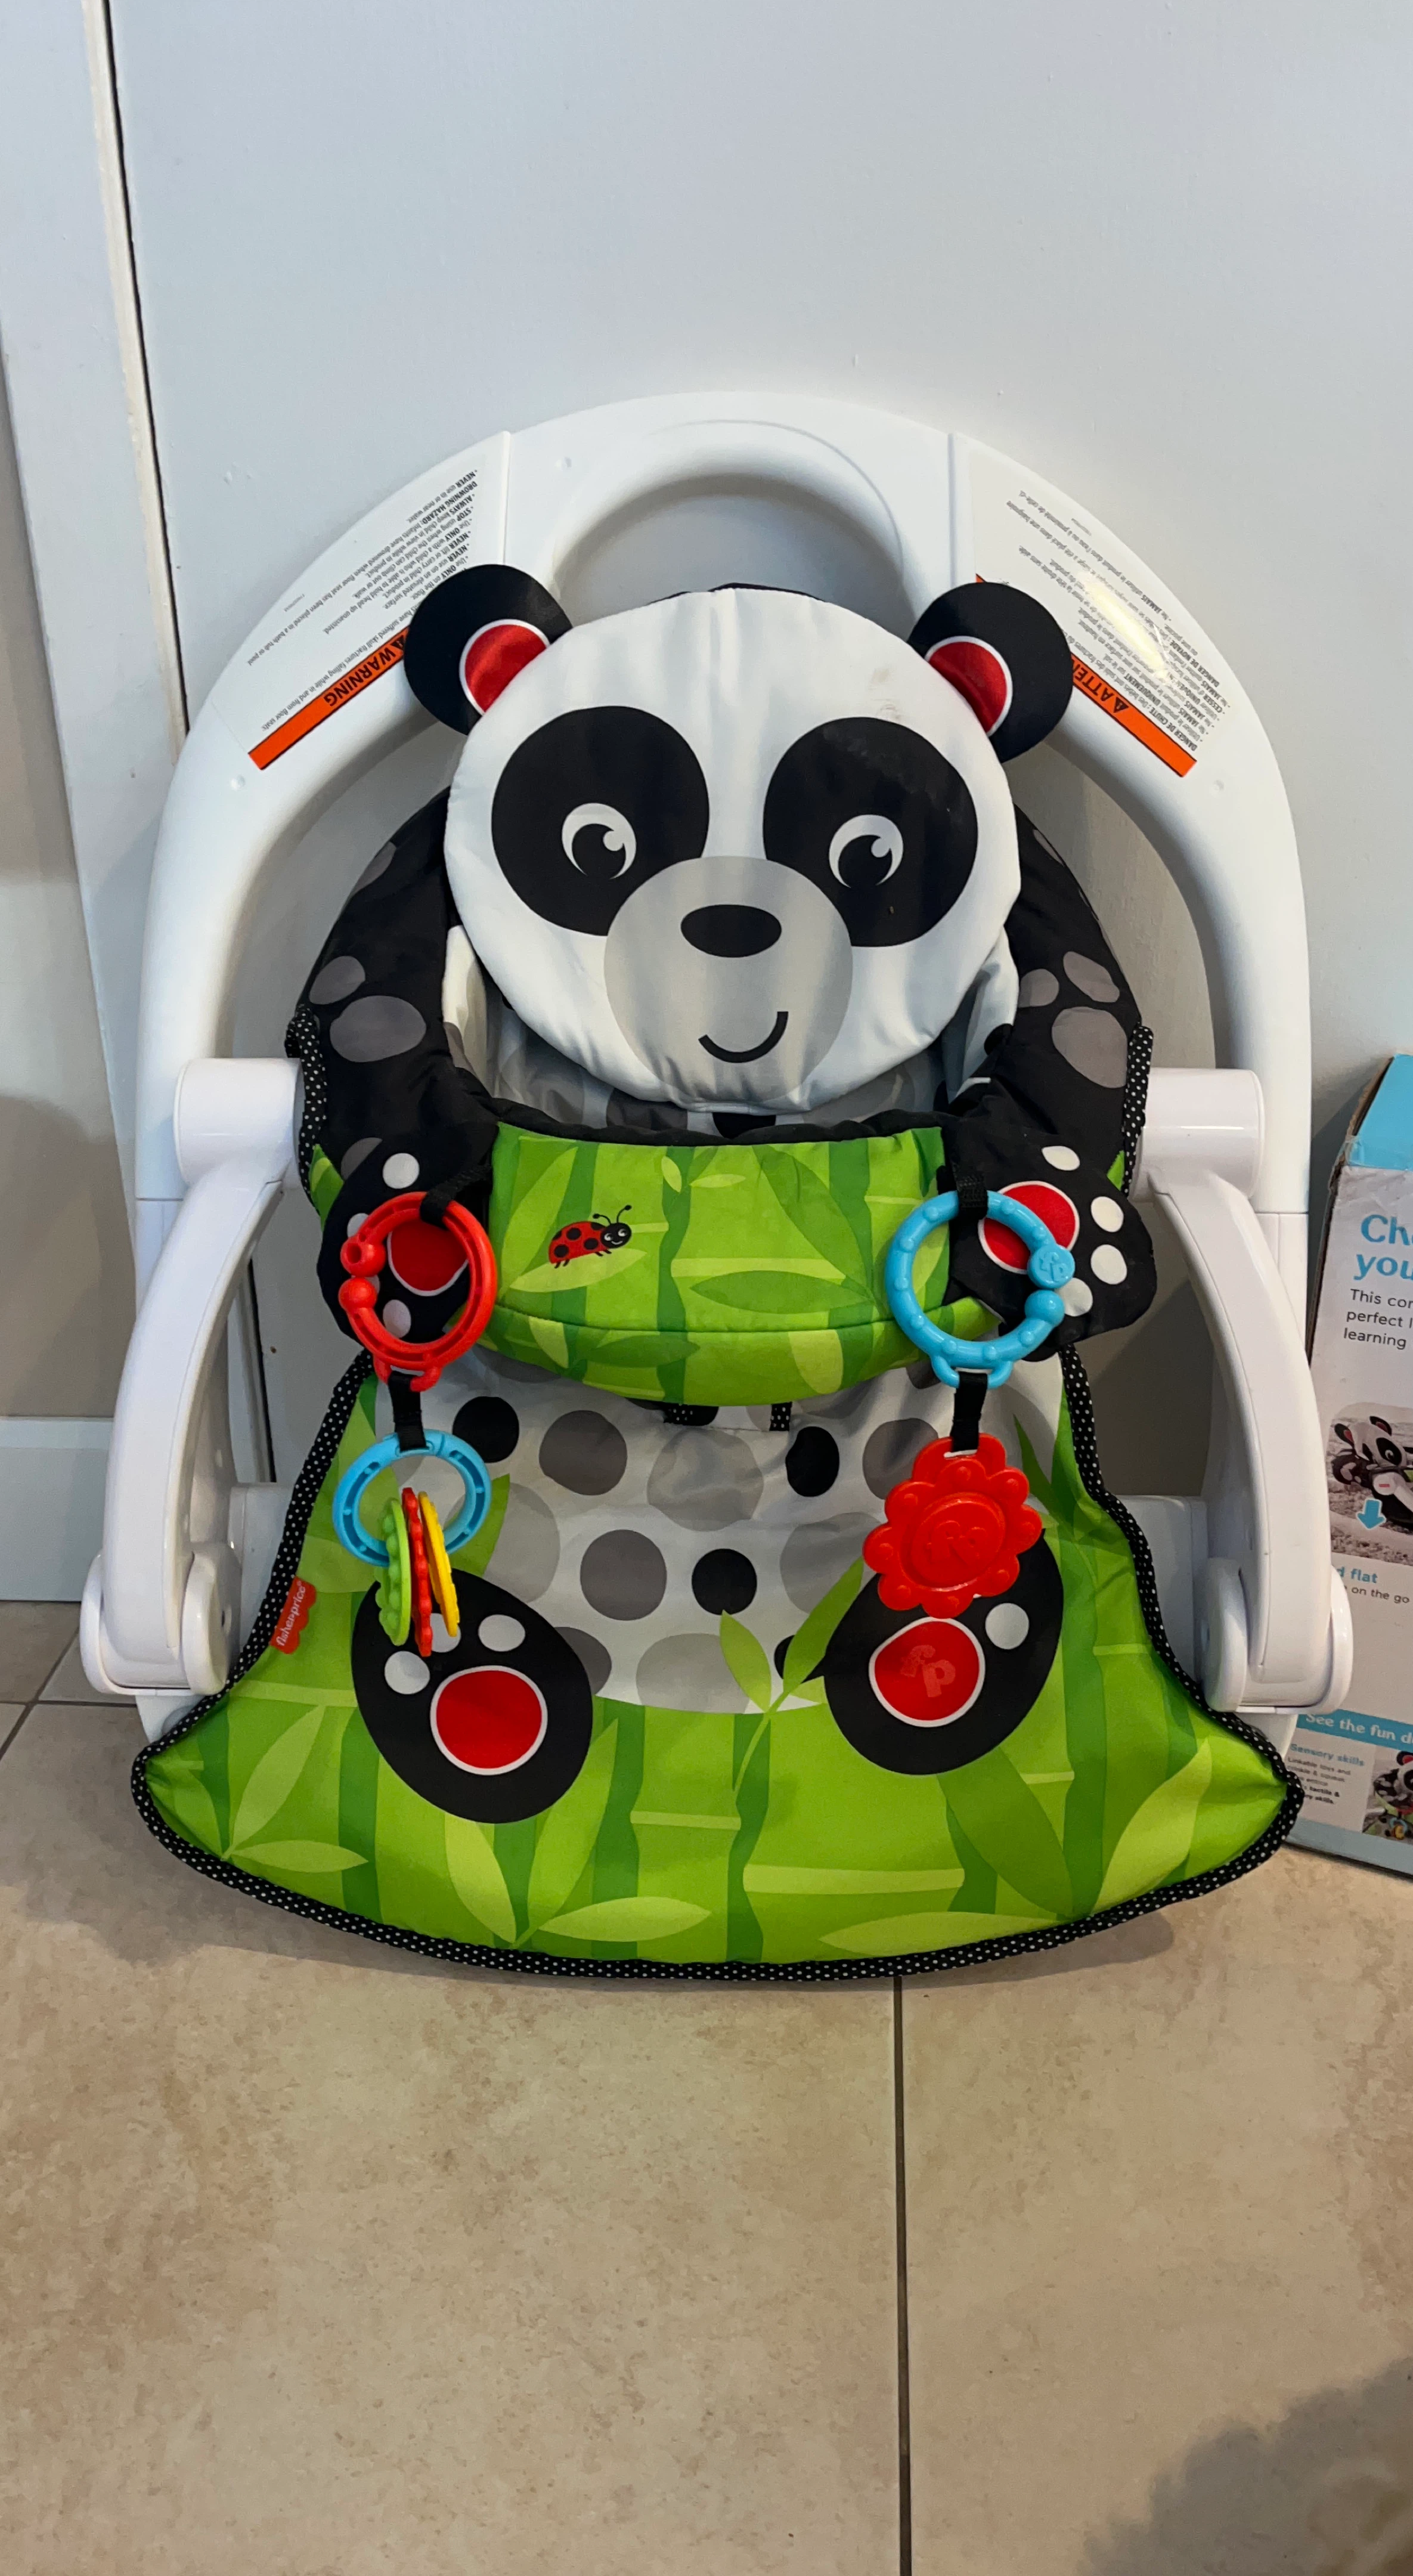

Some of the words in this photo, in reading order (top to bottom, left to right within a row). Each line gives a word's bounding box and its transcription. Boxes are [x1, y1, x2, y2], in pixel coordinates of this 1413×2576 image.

[455, 471, 475, 488] NEVER
[444, 480, 478, 507] DROWNING
[448, 495, 472, 515] ALWAYS
[455, 507, 472, 521] STOP
[444, 527, 460, 541] ONLY
[448, 532, 469, 549] NEVER
[447, 544, 467, 562] NEVER
[440, 564, 456, 579] ONLY
[323, 646, 396, 707] WARNING
[1148, 707, 1168, 725] CHUTE
[1173, 729, 1197, 751] DANGER
[1361, 1214, 1413, 1246] Ch
[1350, 1289, 1381, 1305] This
[1346, 1311, 1403, 1327] perfect
[1344, 1327, 1407, 1350] learning
[1351, 1568, 1378, 1583] flat
[1352, 1587, 1367, 1596] on
[1371, 1589, 1390, 1600] the
[1394, 1594, 1410, 1604] go
[900, 1644, 956, 1698] fp
[1306, 1714, 1335, 1727] See
[1339, 1719, 1365, 1733] the
[1370, 1724, 1396, 1741] fun
[1401, 1732, 1413, 1745] d
[1290, 1744, 1334, 1761] Sensory
[1337, 1754, 1365, 1767] skills
